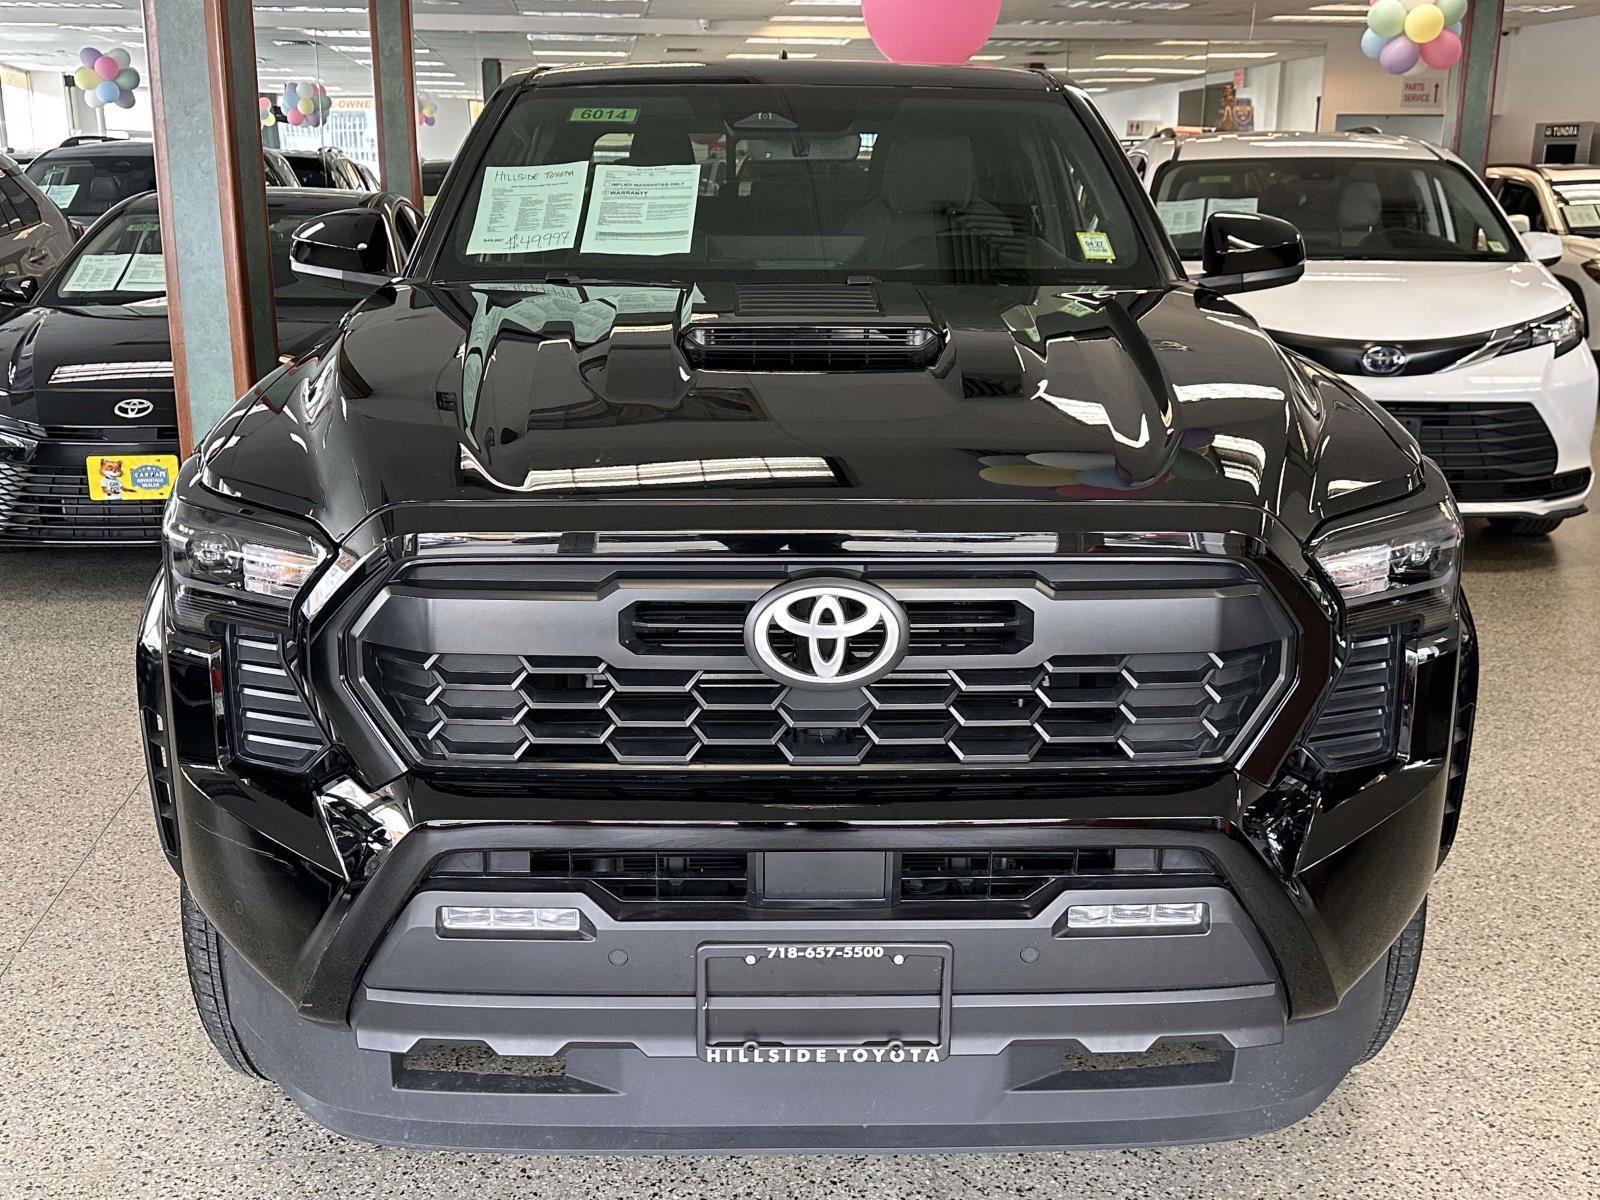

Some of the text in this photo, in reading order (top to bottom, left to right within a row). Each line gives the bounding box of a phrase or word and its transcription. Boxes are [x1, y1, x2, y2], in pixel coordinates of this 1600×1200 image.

[580, 109, 628, 120] 6014
[494, 170, 539, 181] HILLSIDE
[767, 947, 884, 959] 718-657-5500
[706, 1049, 940, 1062] HILLSIDE TOYOTA
